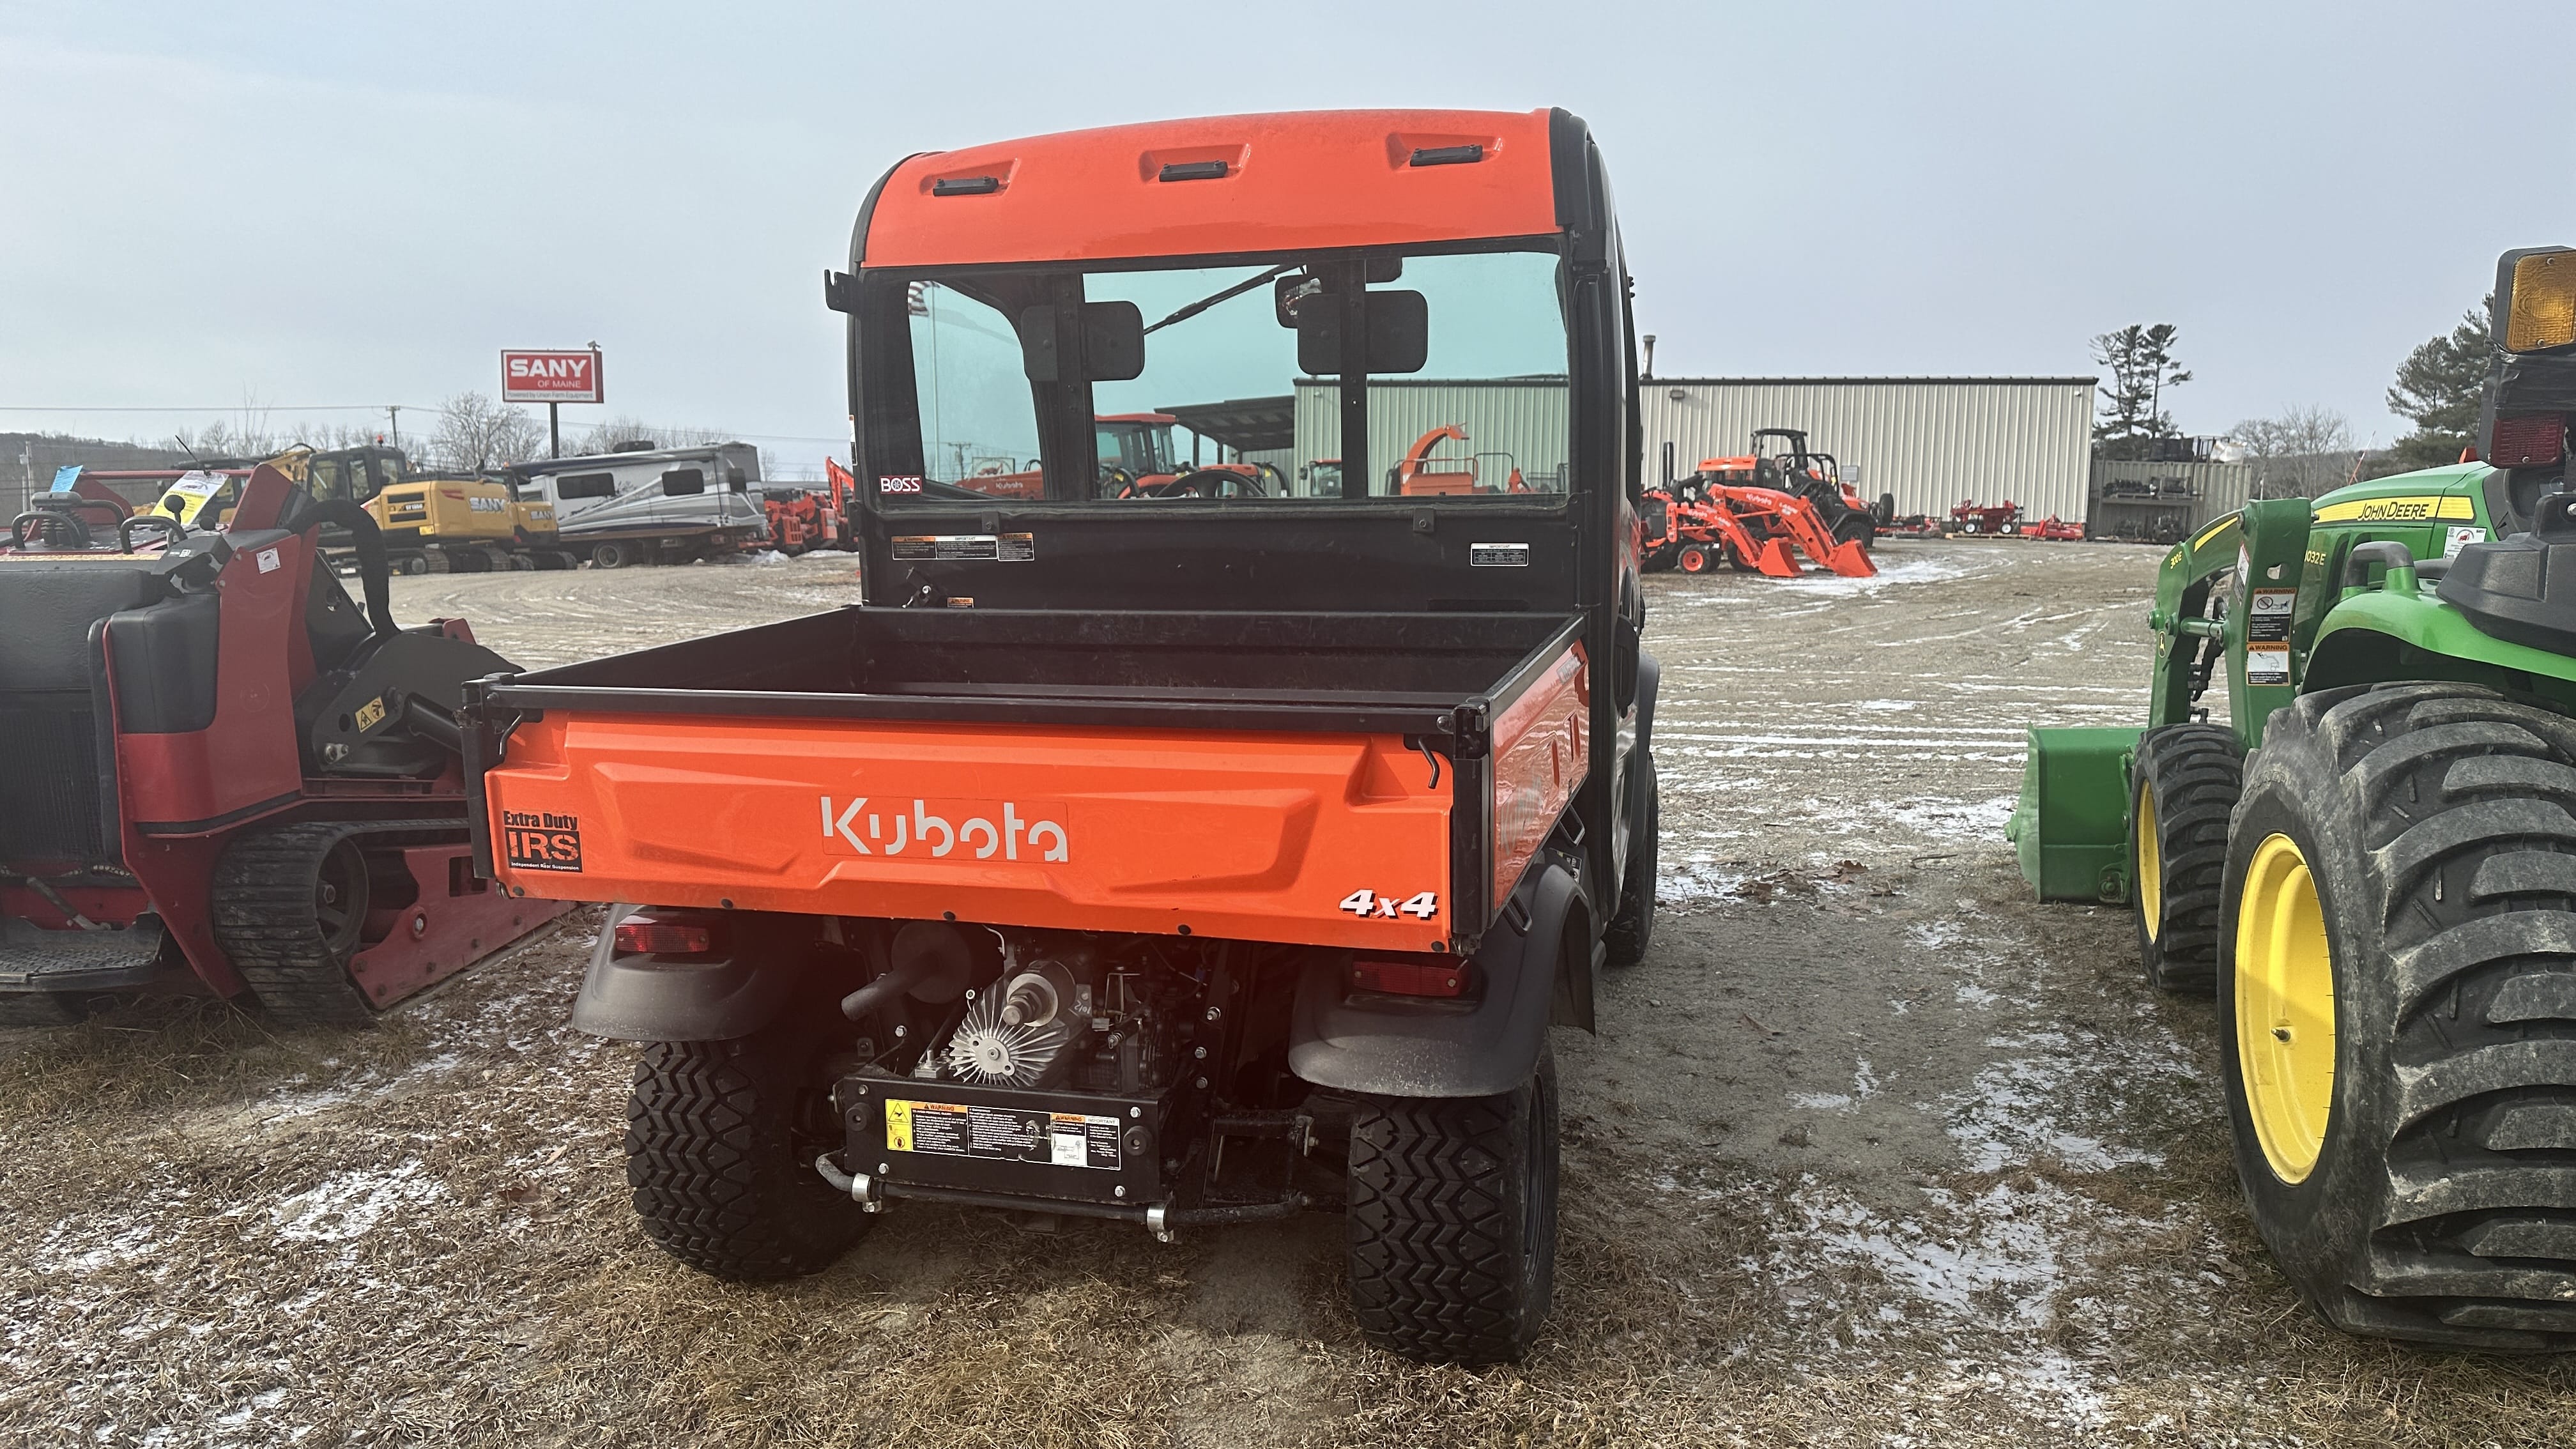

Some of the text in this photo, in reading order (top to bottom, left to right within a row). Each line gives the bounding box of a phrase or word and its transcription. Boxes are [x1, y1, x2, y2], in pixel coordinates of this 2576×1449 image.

[510, 359, 587, 378] SANY
[552, 380, 581, 388] MAINE
[880, 477, 920, 492] BOSS
[470, 497, 505, 512] SANY
[2358, 502, 2429, 519] JOHN DEERE
[2170, 551, 2182, 569] 300E
[2304, 550, 2326, 566] 032E
[503, 810, 578, 831] Extra Duty
[820, 796, 1068, 862] Kubota
[509, 831, 578, 861] IRS
[1339, 889, 1438, 921] 4x4
